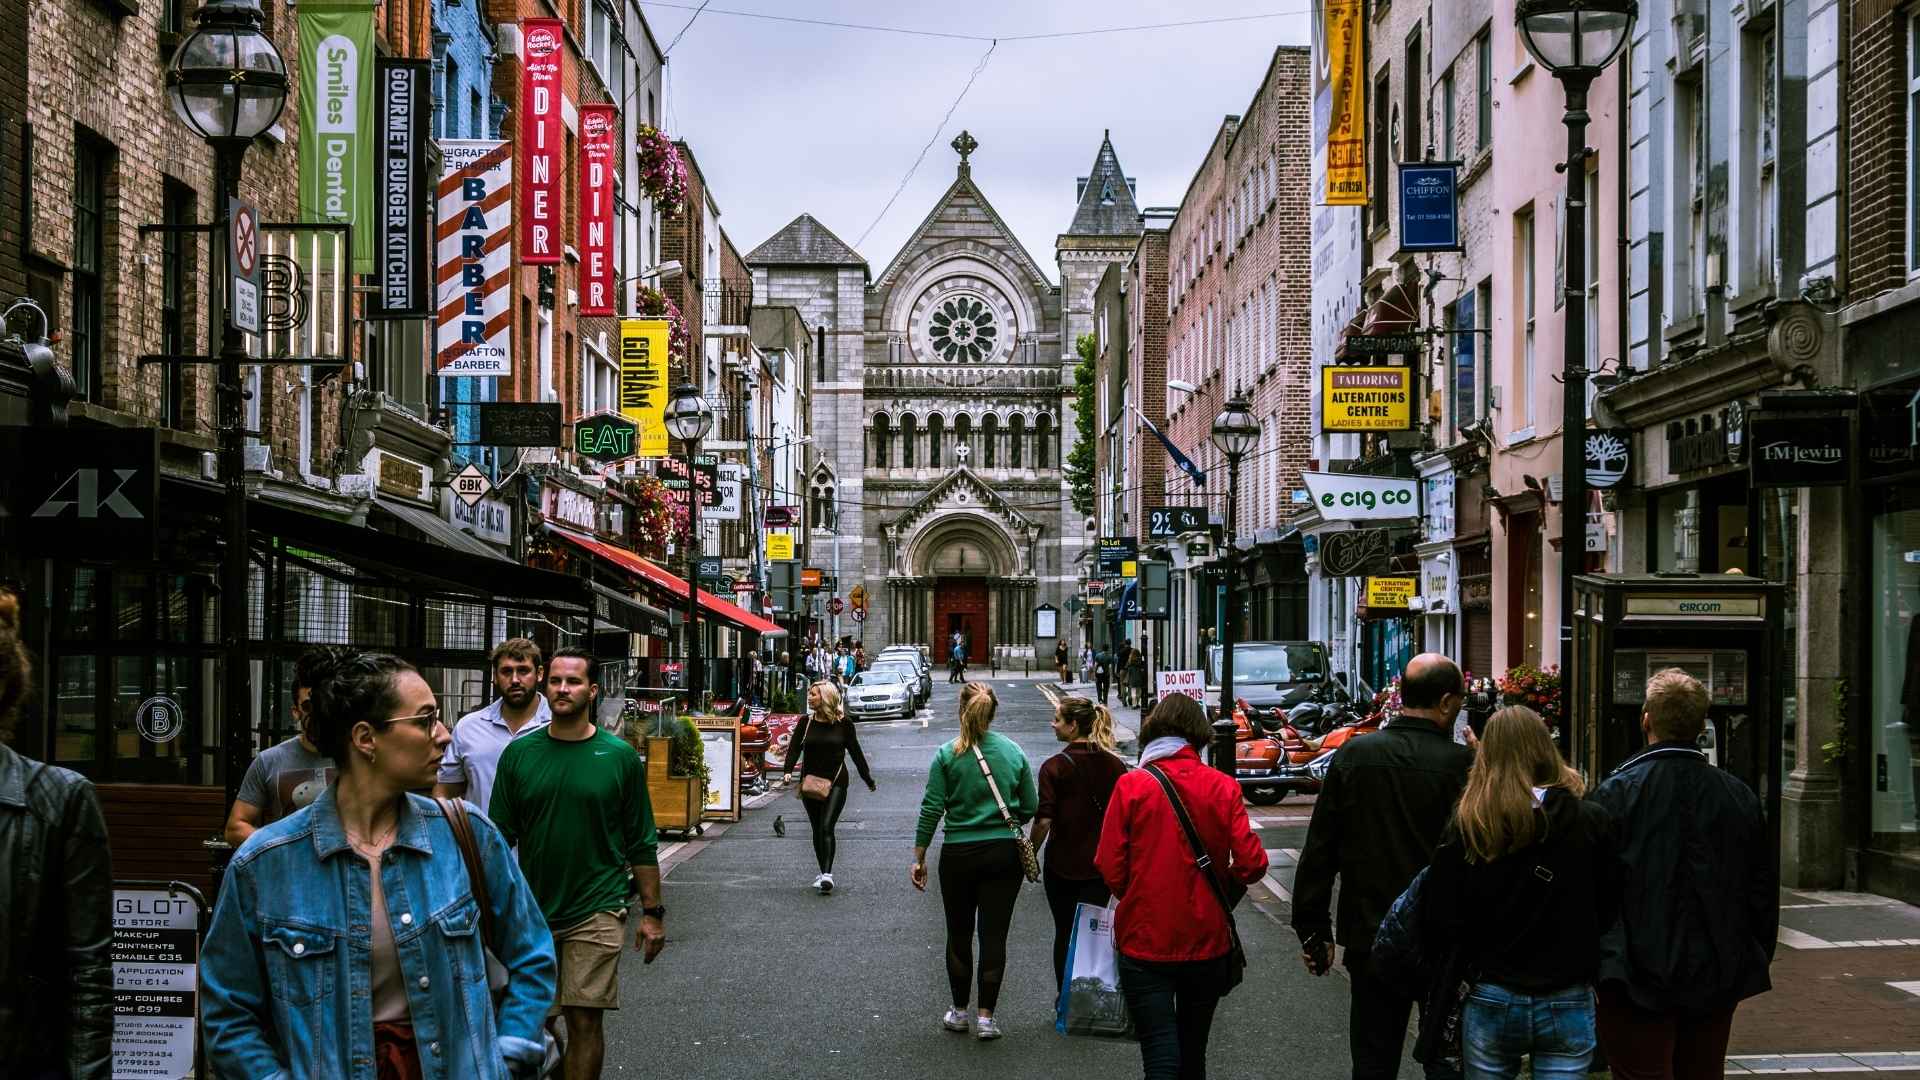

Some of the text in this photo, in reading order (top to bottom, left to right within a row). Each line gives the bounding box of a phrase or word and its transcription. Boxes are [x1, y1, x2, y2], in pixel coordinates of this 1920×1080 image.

[1341, 20, 1351, 135] ALTERATION
[326, 48, 348, 220] Smiles Dental
[454, 149, 504, 158] GRAFTON
[1331, 143, 1361, 166] CENTRE
[456, 161, 500, 171] BARBER
[533, 86, 549, 254] DINER
[388, 68, 408, 309] GOURMET BURGER KITCHEN
[1406, 185, 1449, 196] CHIFFON
[589, 162, 604, 308] DINER
[461, 177, 488, 345] BARBER
[454, 348, 506, 358] GRAFTON
[454, 361, 500, 370] BARBER
[623, 336, 661, 408] GOTHAM
[1337, 372, 1398, 386] TAILORING
[1332, 391, 1405, 404] ALTERATIONS
[1347, 406, 1389, 417] CENTRE
[1332, 418, 1362, 427] LADIES
[1375, 418, 1404, 427] GENTS
[579, 423, 634, 455] EAT
[662, 457, 711, 489] KEHES
[460, 480, 481, 490] GBK
[662, 479, 690, 488] SPIRITS
[1321, 489, 1412, 510] e cig co
[826, 601, 844, 612] SOP
[1165, 673, 1196, 685] DO NOT
[1184, 689, 1203, 700] THIS
[116, 898, 189, 915] GLOT
[112, 918, 170, 928] RO STORE
[112, 942, 175, 951] POINTMENTS
[111, 953, 183, 962] EEMABLE €35
[146, 976, 169, 986] €14
[135, 995, 183, 1004] COURSES
[137, 1005, 161, 1014] €99
